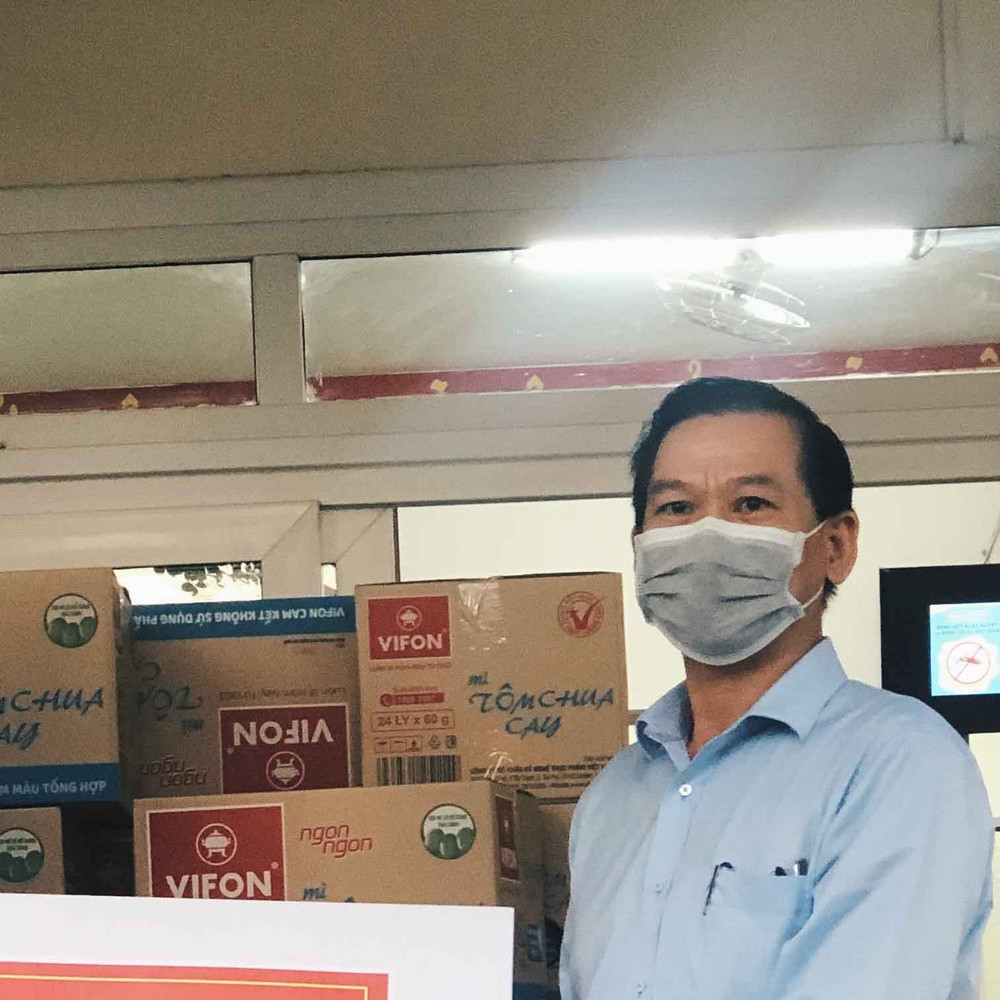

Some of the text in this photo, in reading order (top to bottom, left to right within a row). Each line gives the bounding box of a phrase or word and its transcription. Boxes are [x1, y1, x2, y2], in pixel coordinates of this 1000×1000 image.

[160, 607, 345, 626] VIFON CAM KẾT KHÔNG SỬ DỤNG
[378, 633, 443, 652] VIFON
[233, 718, 333, 746] VIFON
[505, 716, 562, 740] CAY
[12, 776, 107, 796] MÀU TỔNG HỢP
[300, 825, 349, 845] ngon
[322, 837, 373, 858] ngon
[166, 871, 272, 898] VIFON
